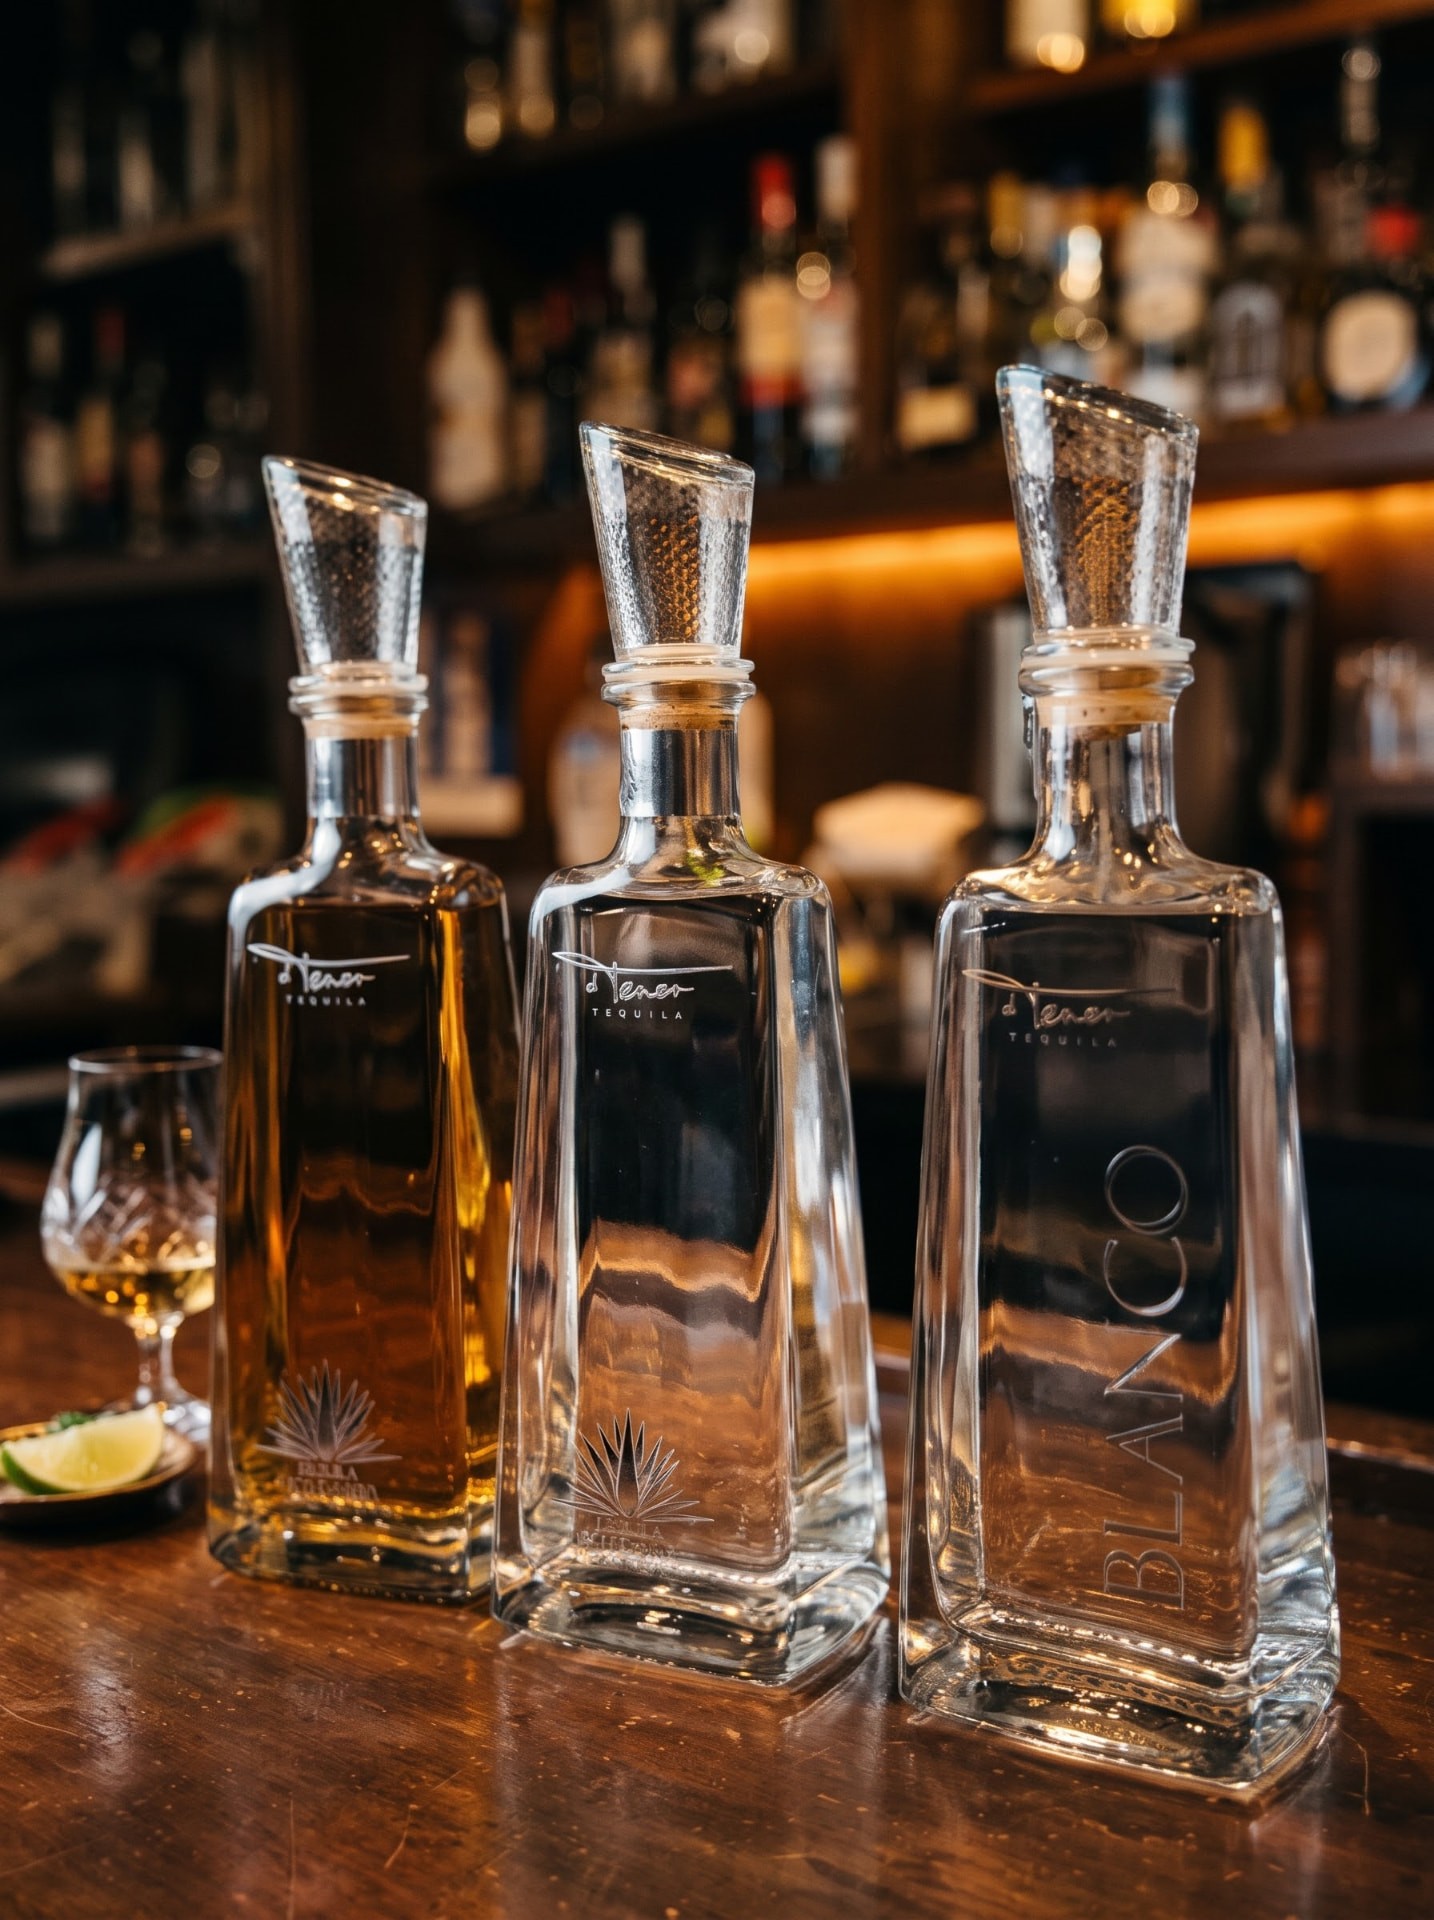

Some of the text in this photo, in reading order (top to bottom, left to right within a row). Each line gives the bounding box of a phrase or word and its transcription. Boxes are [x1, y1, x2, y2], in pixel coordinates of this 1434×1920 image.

[285, 995, 366, 1006] TEQUILA
[592, 1007, 683, 1020] TEQUILA
[1008, 1031, 1118, 1048] TEQUILA
[1103, 1144, 1188, 1610] BLANCO
